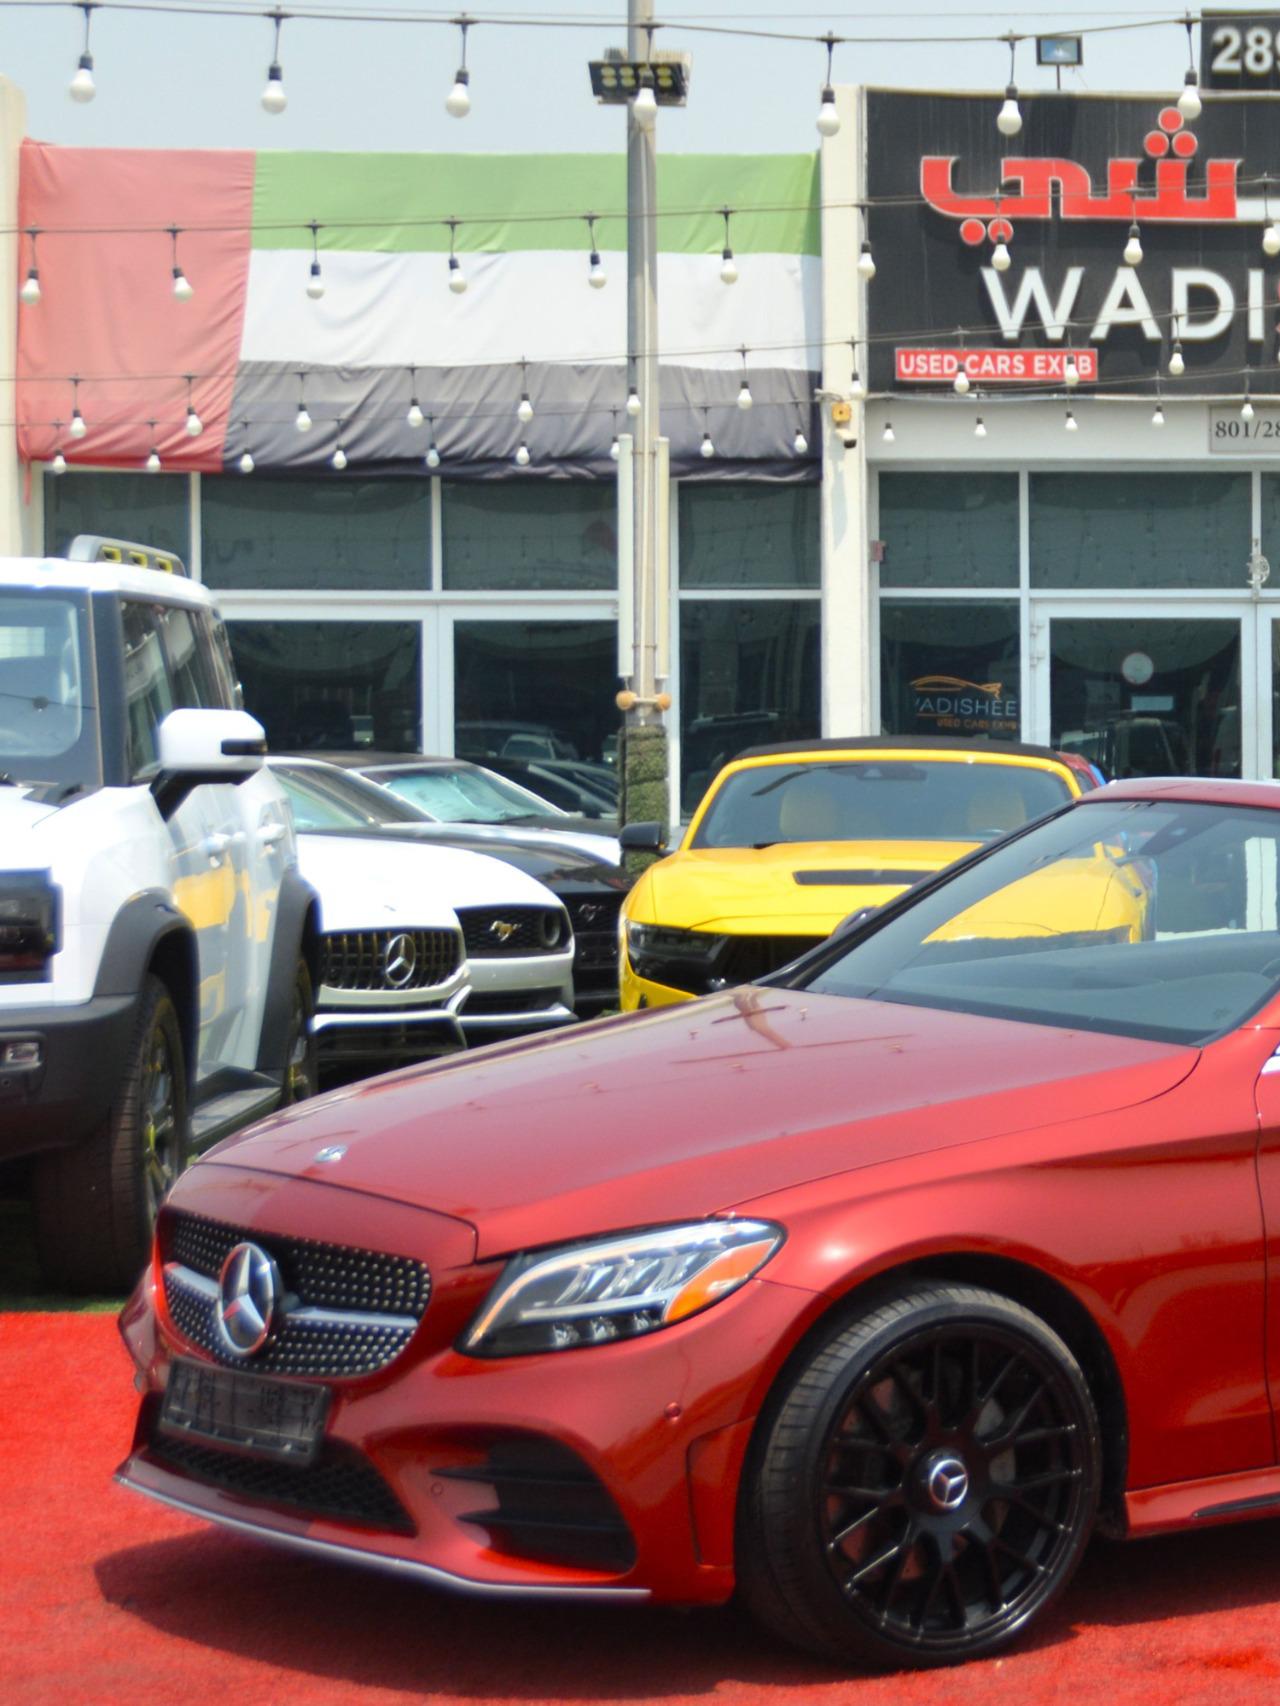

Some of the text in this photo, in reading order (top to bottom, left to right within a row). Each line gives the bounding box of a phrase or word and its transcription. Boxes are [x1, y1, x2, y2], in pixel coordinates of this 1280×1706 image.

[901, 355, 957, 374] USED
[965, 355, 1024, 374] CARS
[915, 698, 1017, 716] ADISHEE
